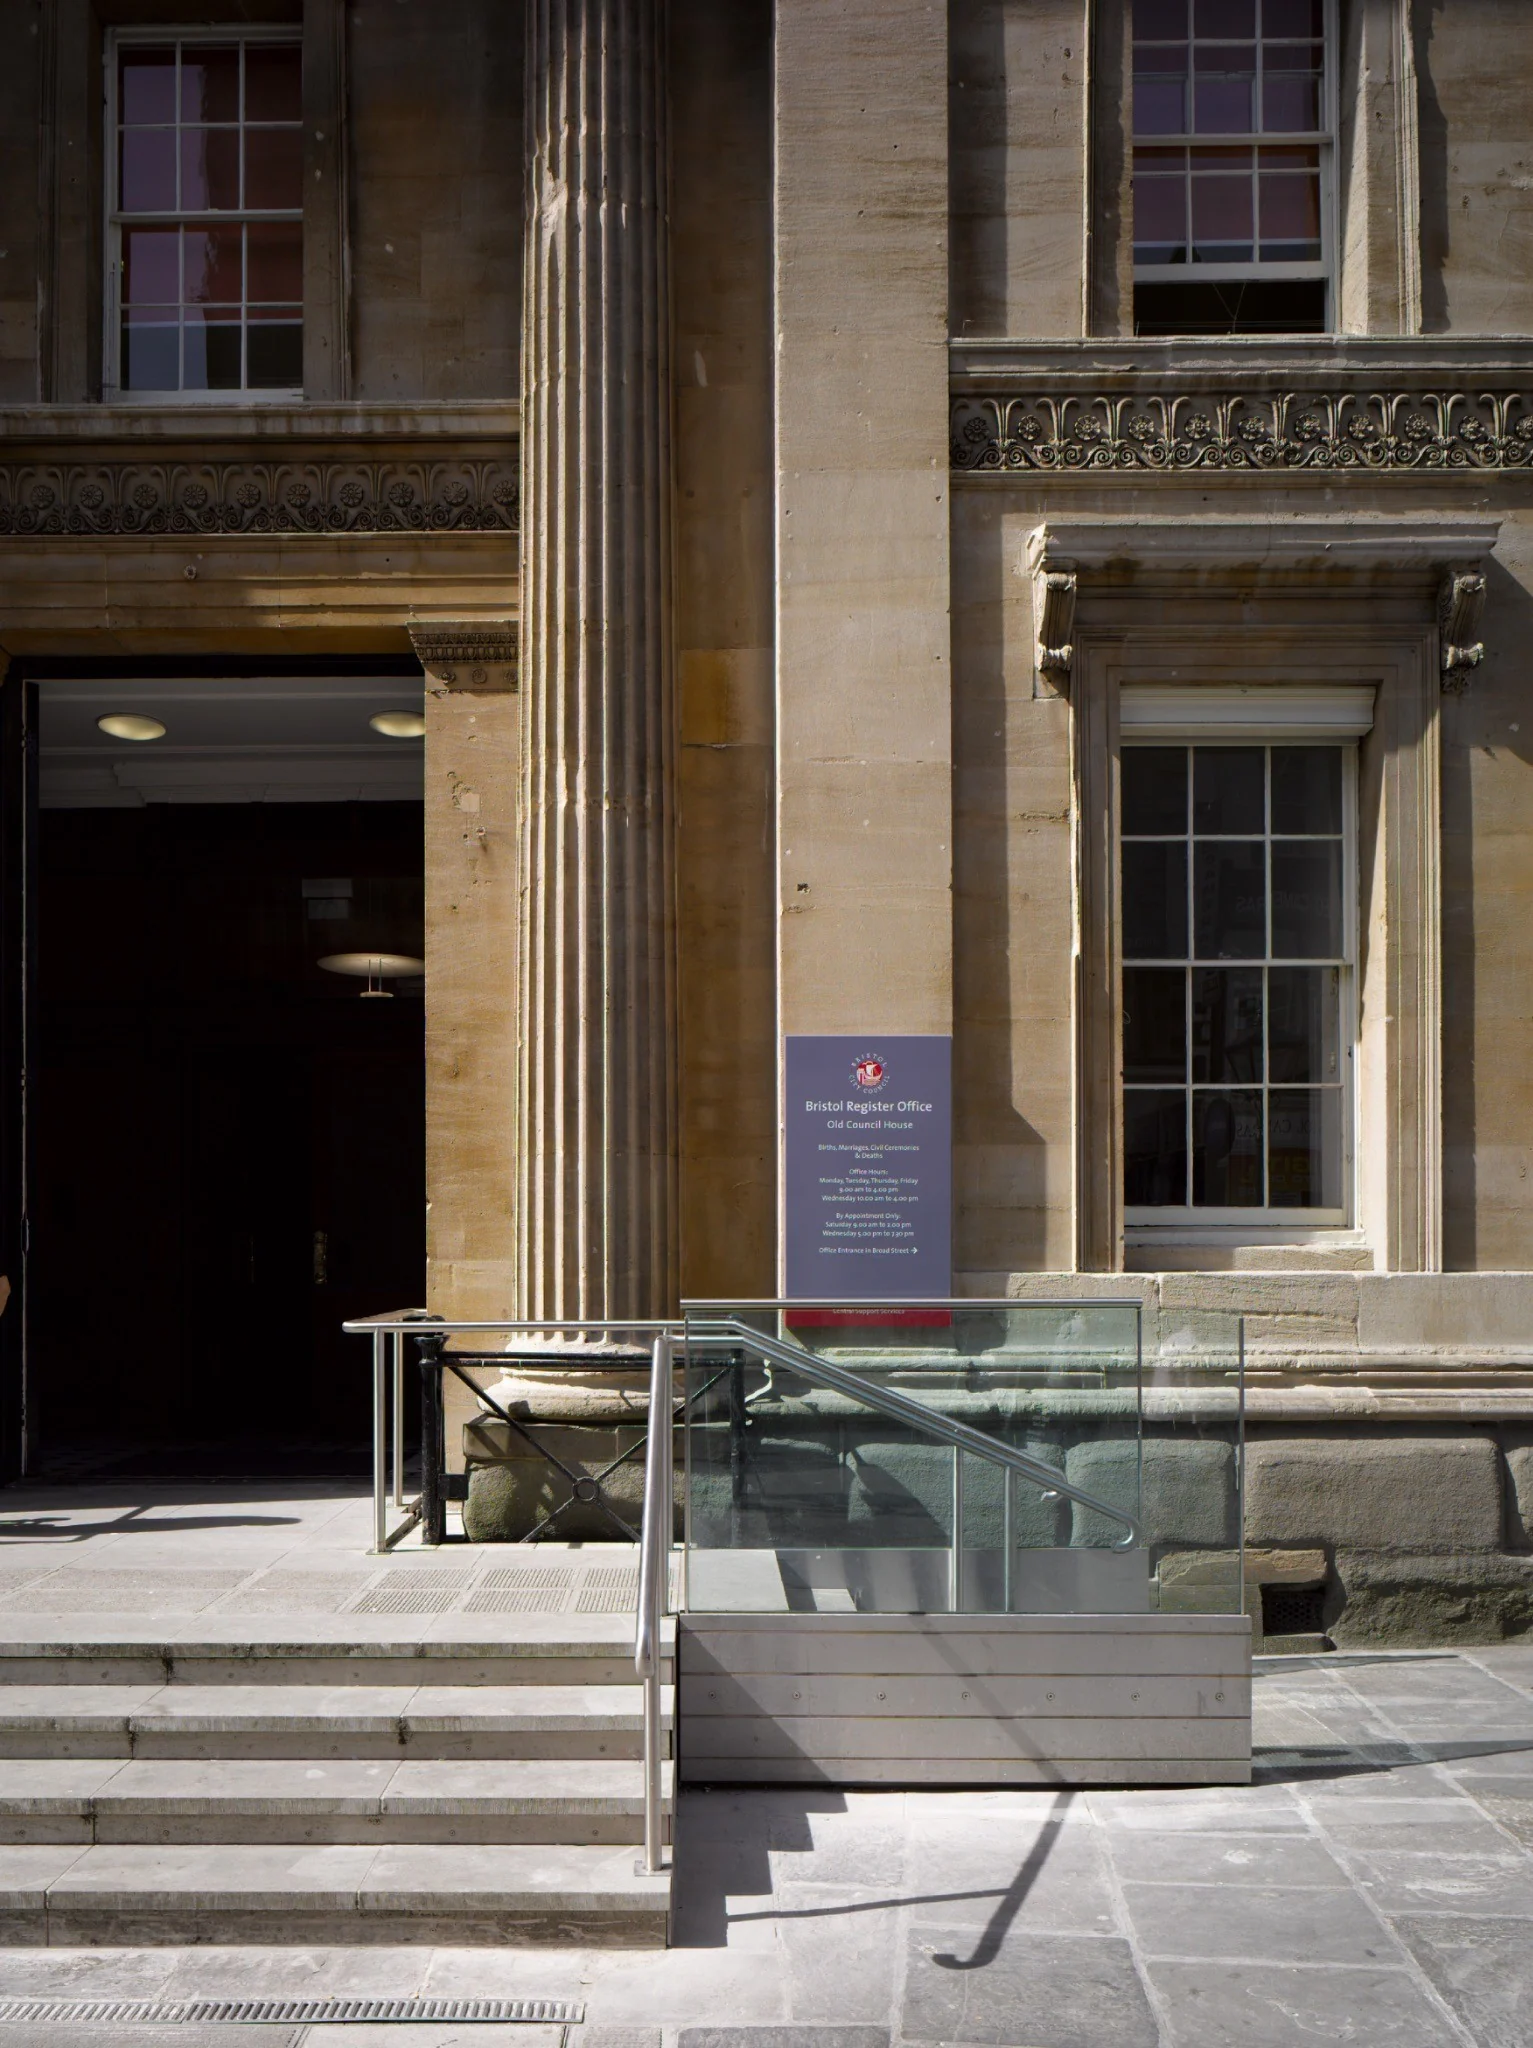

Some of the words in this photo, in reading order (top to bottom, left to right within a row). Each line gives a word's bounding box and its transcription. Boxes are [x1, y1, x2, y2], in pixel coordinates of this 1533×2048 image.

[851, 1053, 887, 1067] BRISTOL
[849, 1074, 861, 1090] CITY
[863, 1076, 890, 1094] COUNCIL
[805, 1100, 844, 1112] Bristol
[847, 1101, 894, 1115] Register
[897, 1101, 932, 1112] Office
[827, 1120, 844, 1129] Old
[847, 1120, 881, 1129] Council
[884, 1121, 913, 1129] House
[818, 1144, 837, 1152] Births,
[838, 1144, 870, 1153] Marriages,
[820, 1177, 844, 1185] Monday,
[846, 1177, 870, 1185] Tuesday,
[871, 1177, 899, 1185] Thursday,
[900, 1177, 918, 1185] Friday
